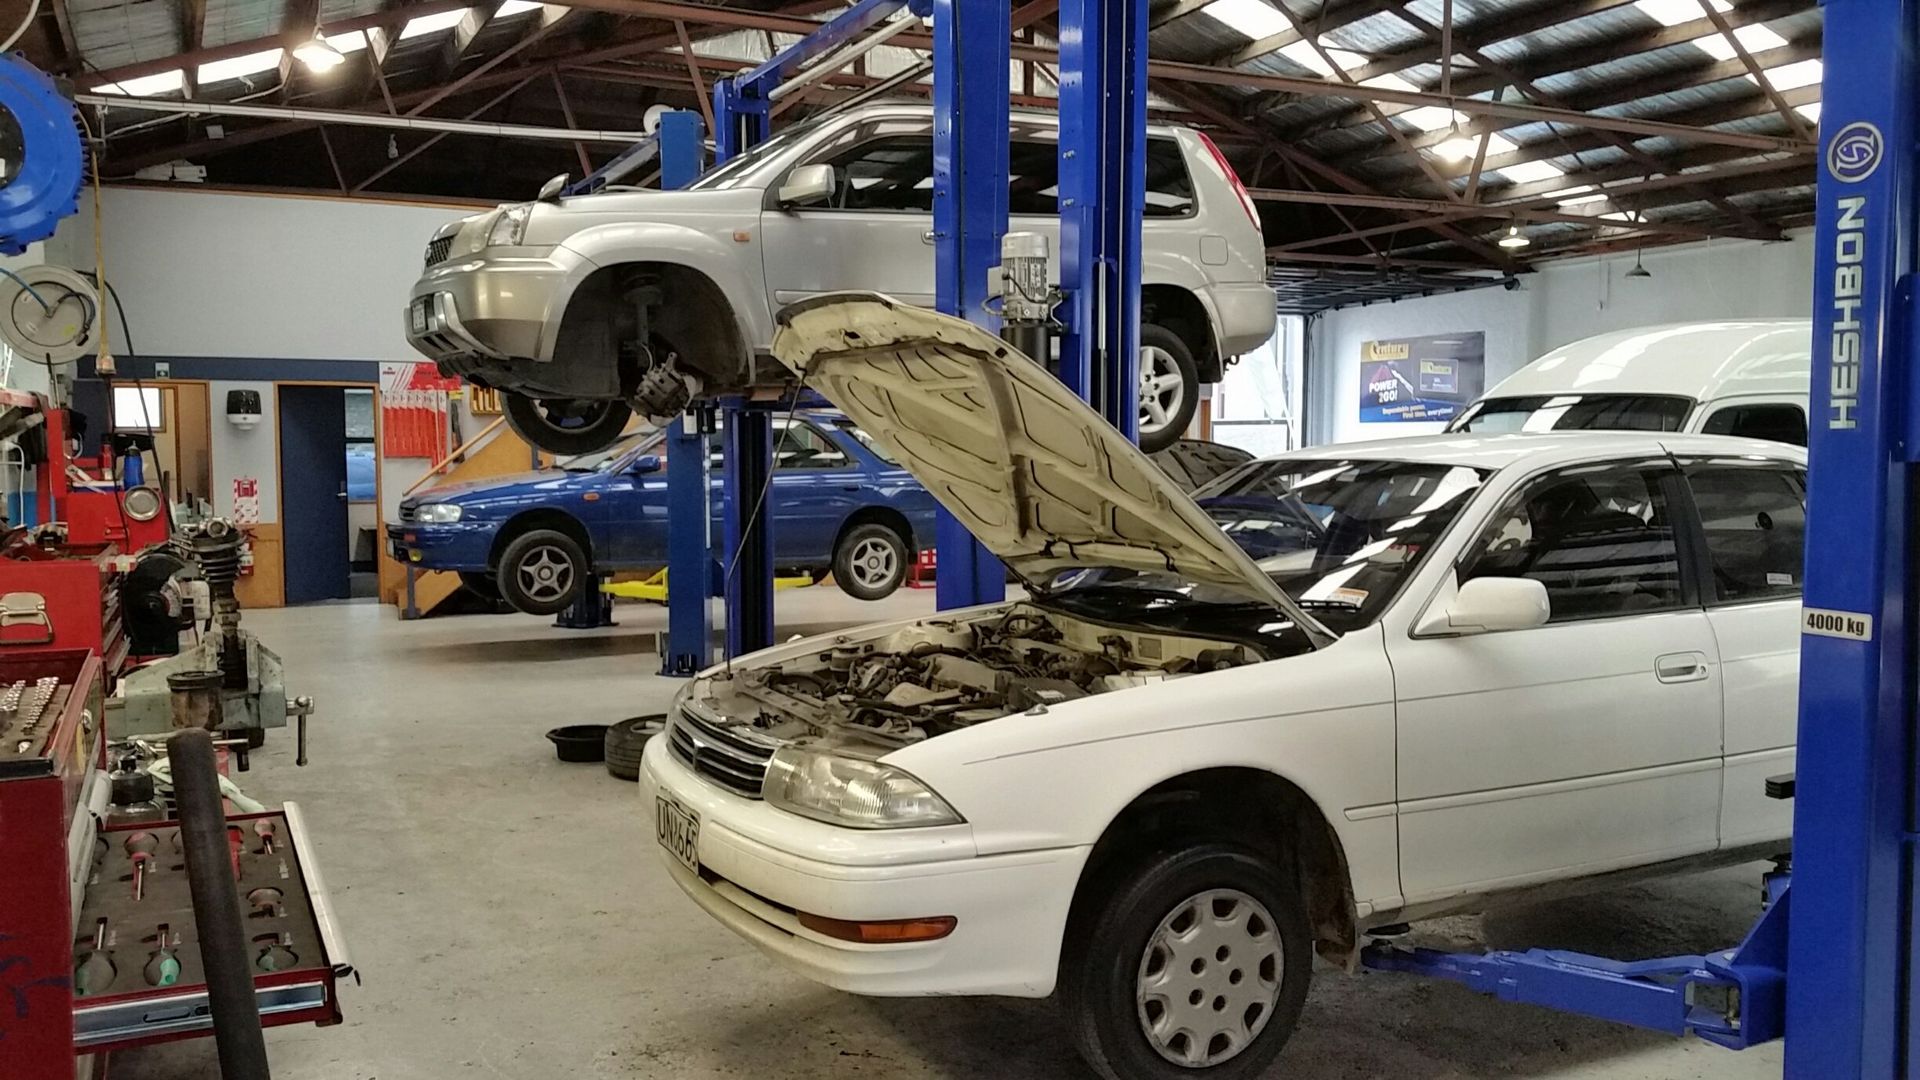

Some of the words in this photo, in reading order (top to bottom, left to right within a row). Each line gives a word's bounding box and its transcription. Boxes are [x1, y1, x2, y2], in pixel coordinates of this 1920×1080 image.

[1830, 197, 1866, 429] HESHBON
[1369, 379, 1398, 393] POWER
[1806, 613, 1844, 632] 4000
[1847, 617, 1865, 637] kg
